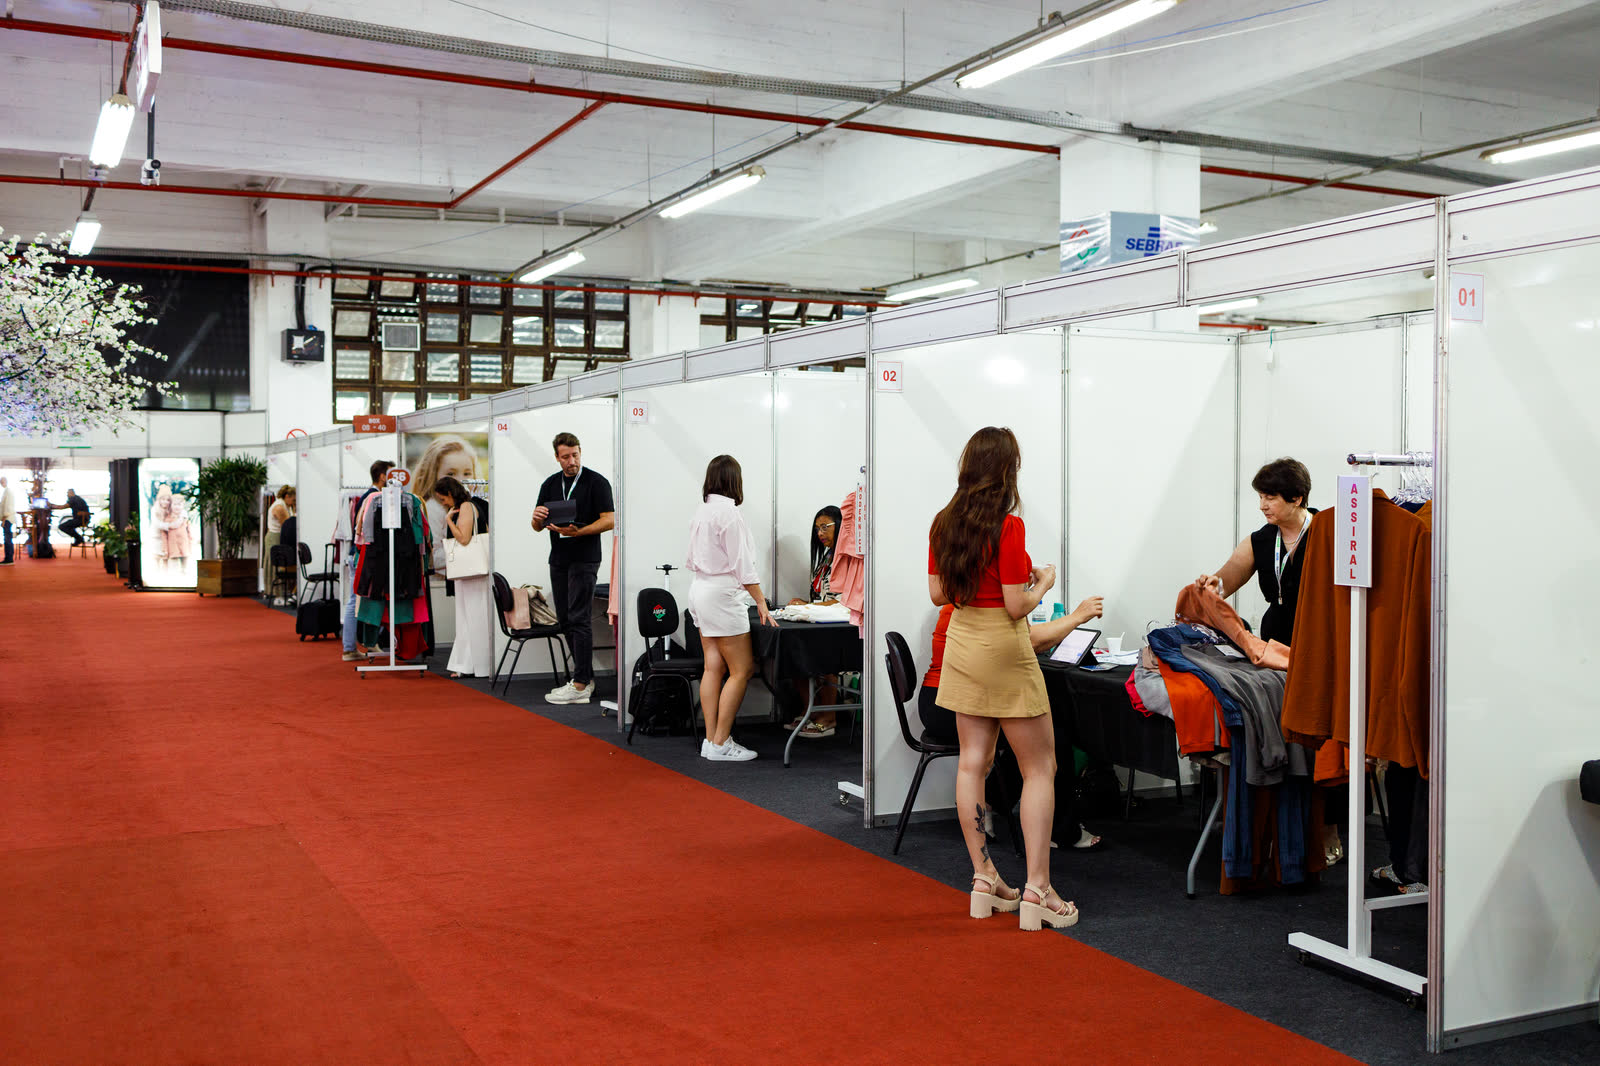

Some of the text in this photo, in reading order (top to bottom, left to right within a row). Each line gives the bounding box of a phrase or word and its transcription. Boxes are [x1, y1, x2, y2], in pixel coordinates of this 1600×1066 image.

[1458, 287, 1475, 307] 01
[883, 370, 897, 381] 02
[632, 407, 644, 417] 03
[497, 423, 508, 431] 04
[1350, 483, 1358, 580] ASSIRAL
